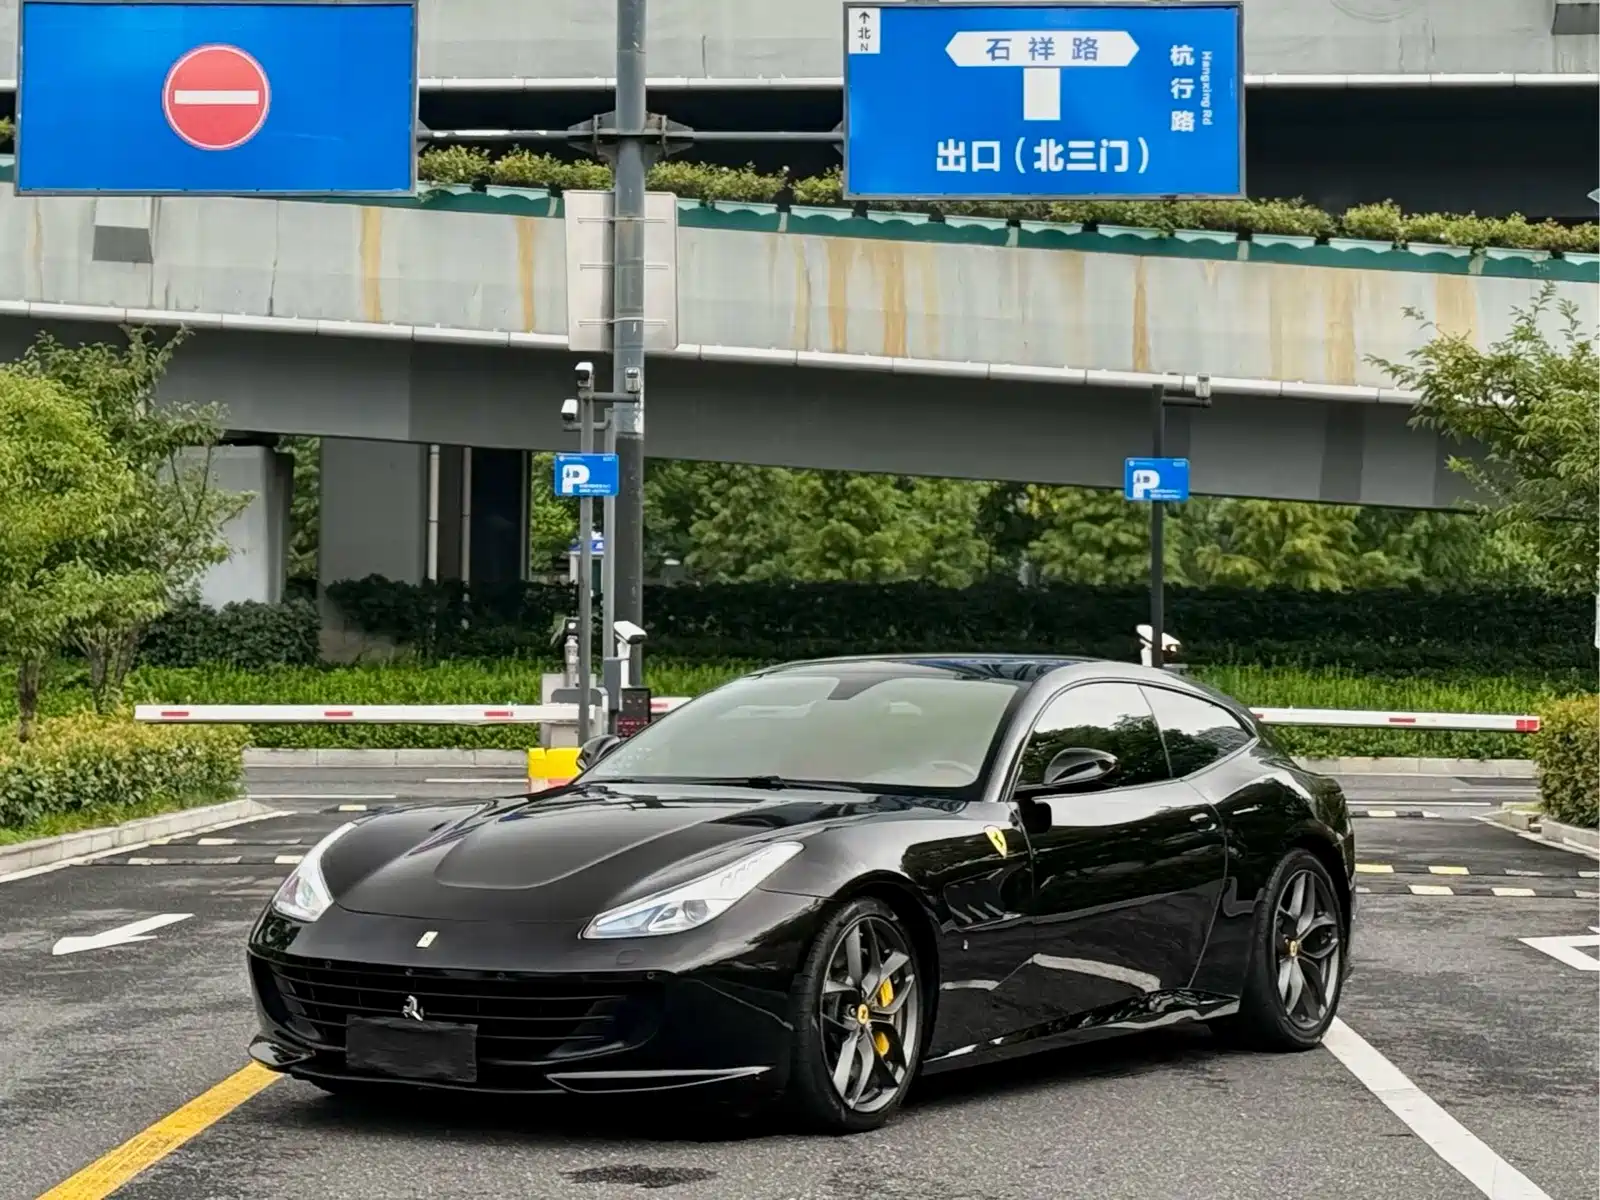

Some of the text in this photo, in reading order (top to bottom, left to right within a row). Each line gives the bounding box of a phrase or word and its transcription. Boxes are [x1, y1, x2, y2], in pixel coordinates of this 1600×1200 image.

[857, 27, 871, 40] 北
[860, 43, 869, 52] N
[986, 36, 1100, 62] 石祥路
[1170, 44, 1195, 132] 杭行路
[1200, 51, 1213, 126] Hangxing Rd
[562, 464, 590, 493] P
[1133, 469, 1160, 499] P
